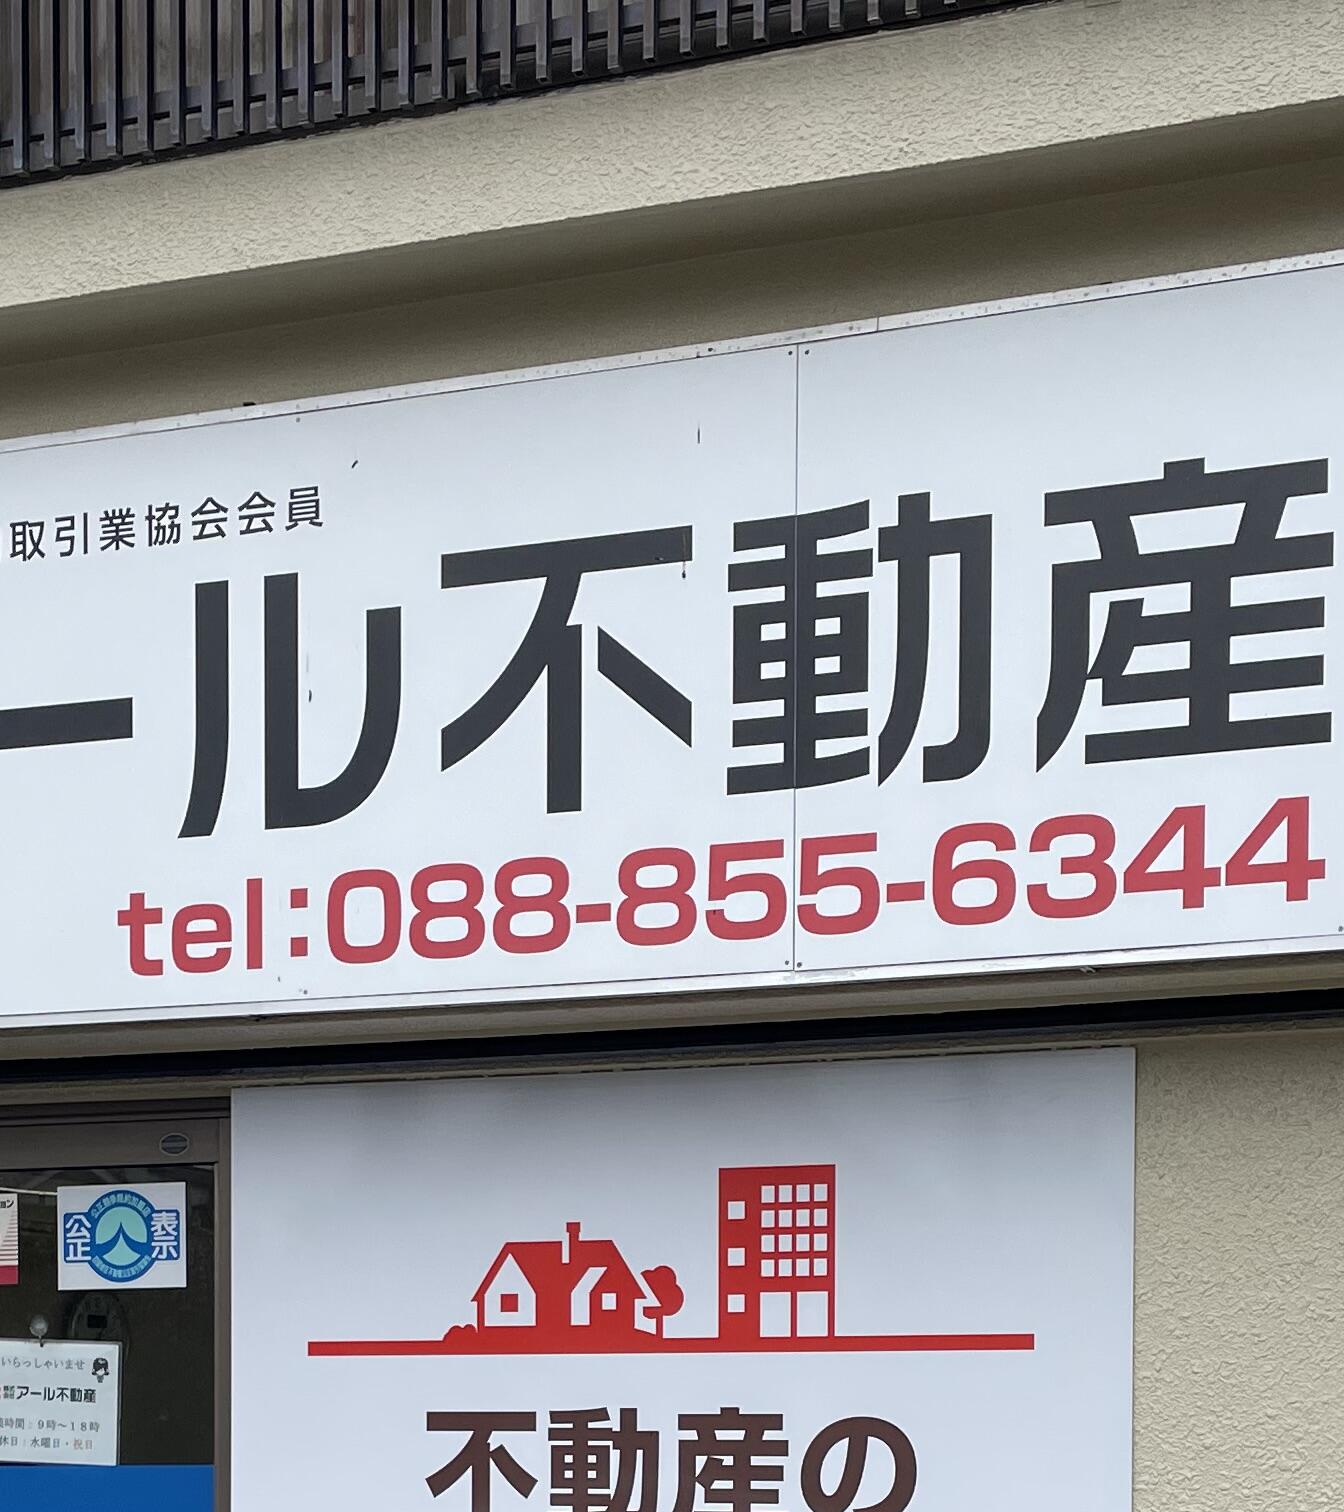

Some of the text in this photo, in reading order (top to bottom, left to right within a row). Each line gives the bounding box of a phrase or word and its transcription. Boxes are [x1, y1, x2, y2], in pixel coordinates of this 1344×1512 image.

[65, 1214, 92, 1261] 公正
[151, 1211, 179, 1260] 表示
[1, 1356, 85, 1370] いらっしゃいませ
[16, 1385, 96, 1403] アール不動産
